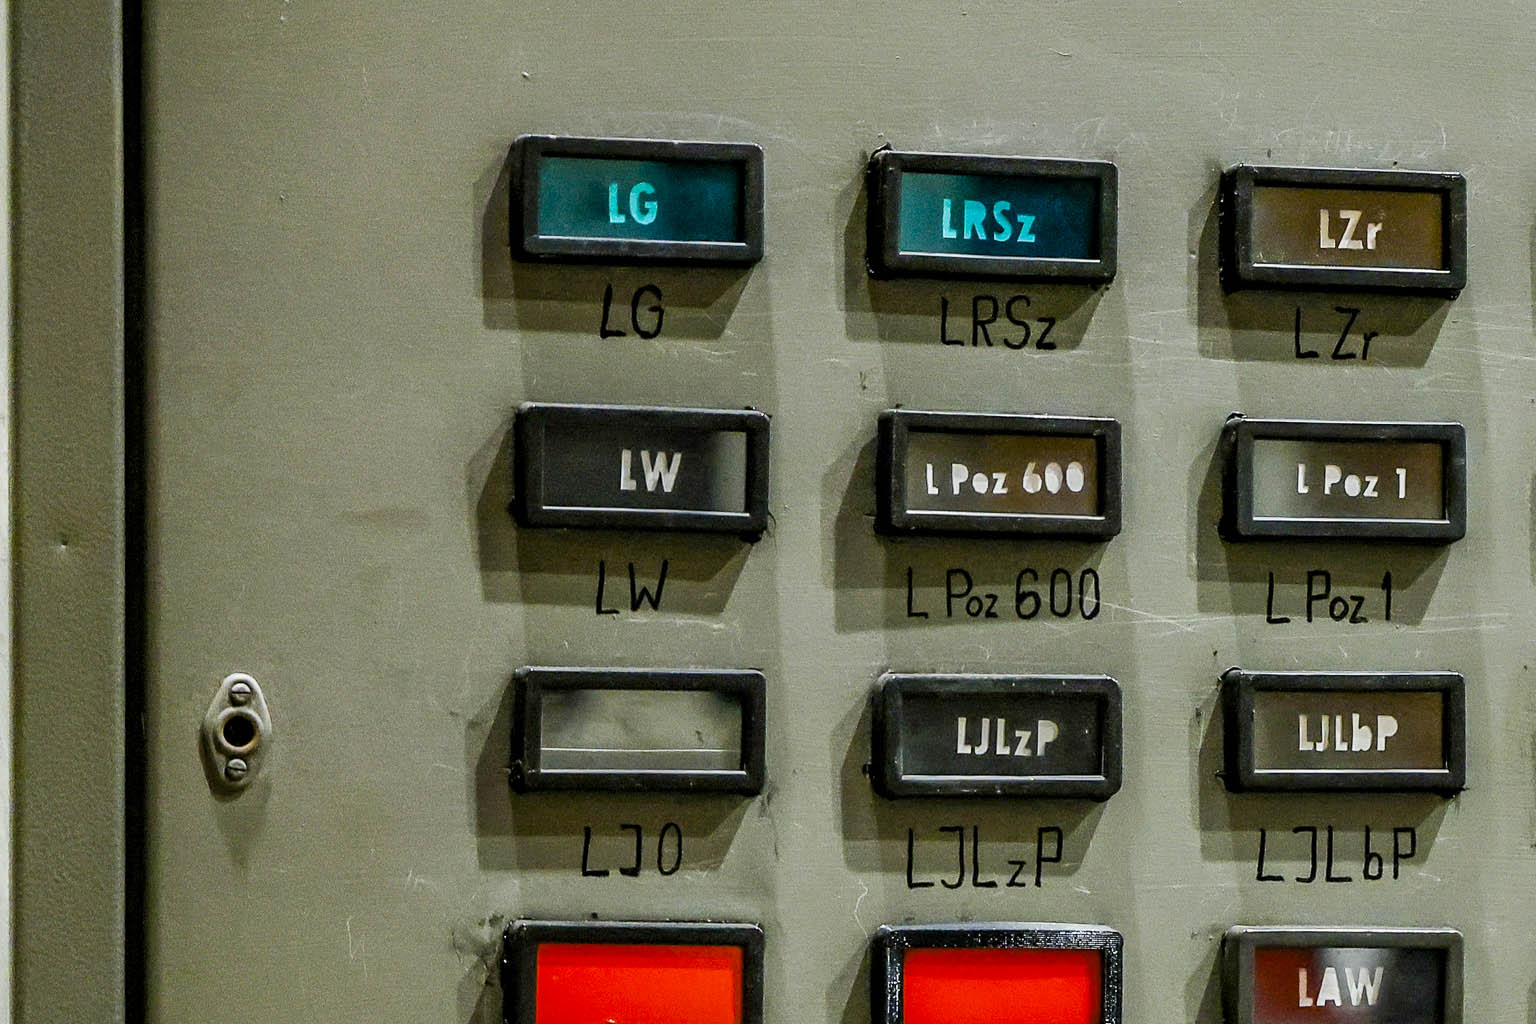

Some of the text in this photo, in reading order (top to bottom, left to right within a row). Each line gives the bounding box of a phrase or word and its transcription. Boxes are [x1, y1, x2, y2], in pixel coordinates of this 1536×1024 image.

[609, 182, 658, 224] LG
[942, 199, 1036, 242] LRSz
[1320, 208, 1384, 251] LZr
[601, 284, 664, 339] LG
[940, 295, 1057, 349] LRSz
[1294, 307, 1378, 360] LZr
[620, 449, 682, 493] LW
[926, 461, 1084, 495] L Poz 600
[1298, 463, 1408, 499] L Poz 1
[596, 559, 668, 615] LW
[1016, 567, 1100, 620] 600
[956, 717, 1058, 757] LJLzP
[1299, 714, 1398, 753] LJLbP
[906, 826, 1062, 888] LJLzP
[1257, 826, 1416, 883] LJLbP
[1298, 967, 1384, 1007] LAW
